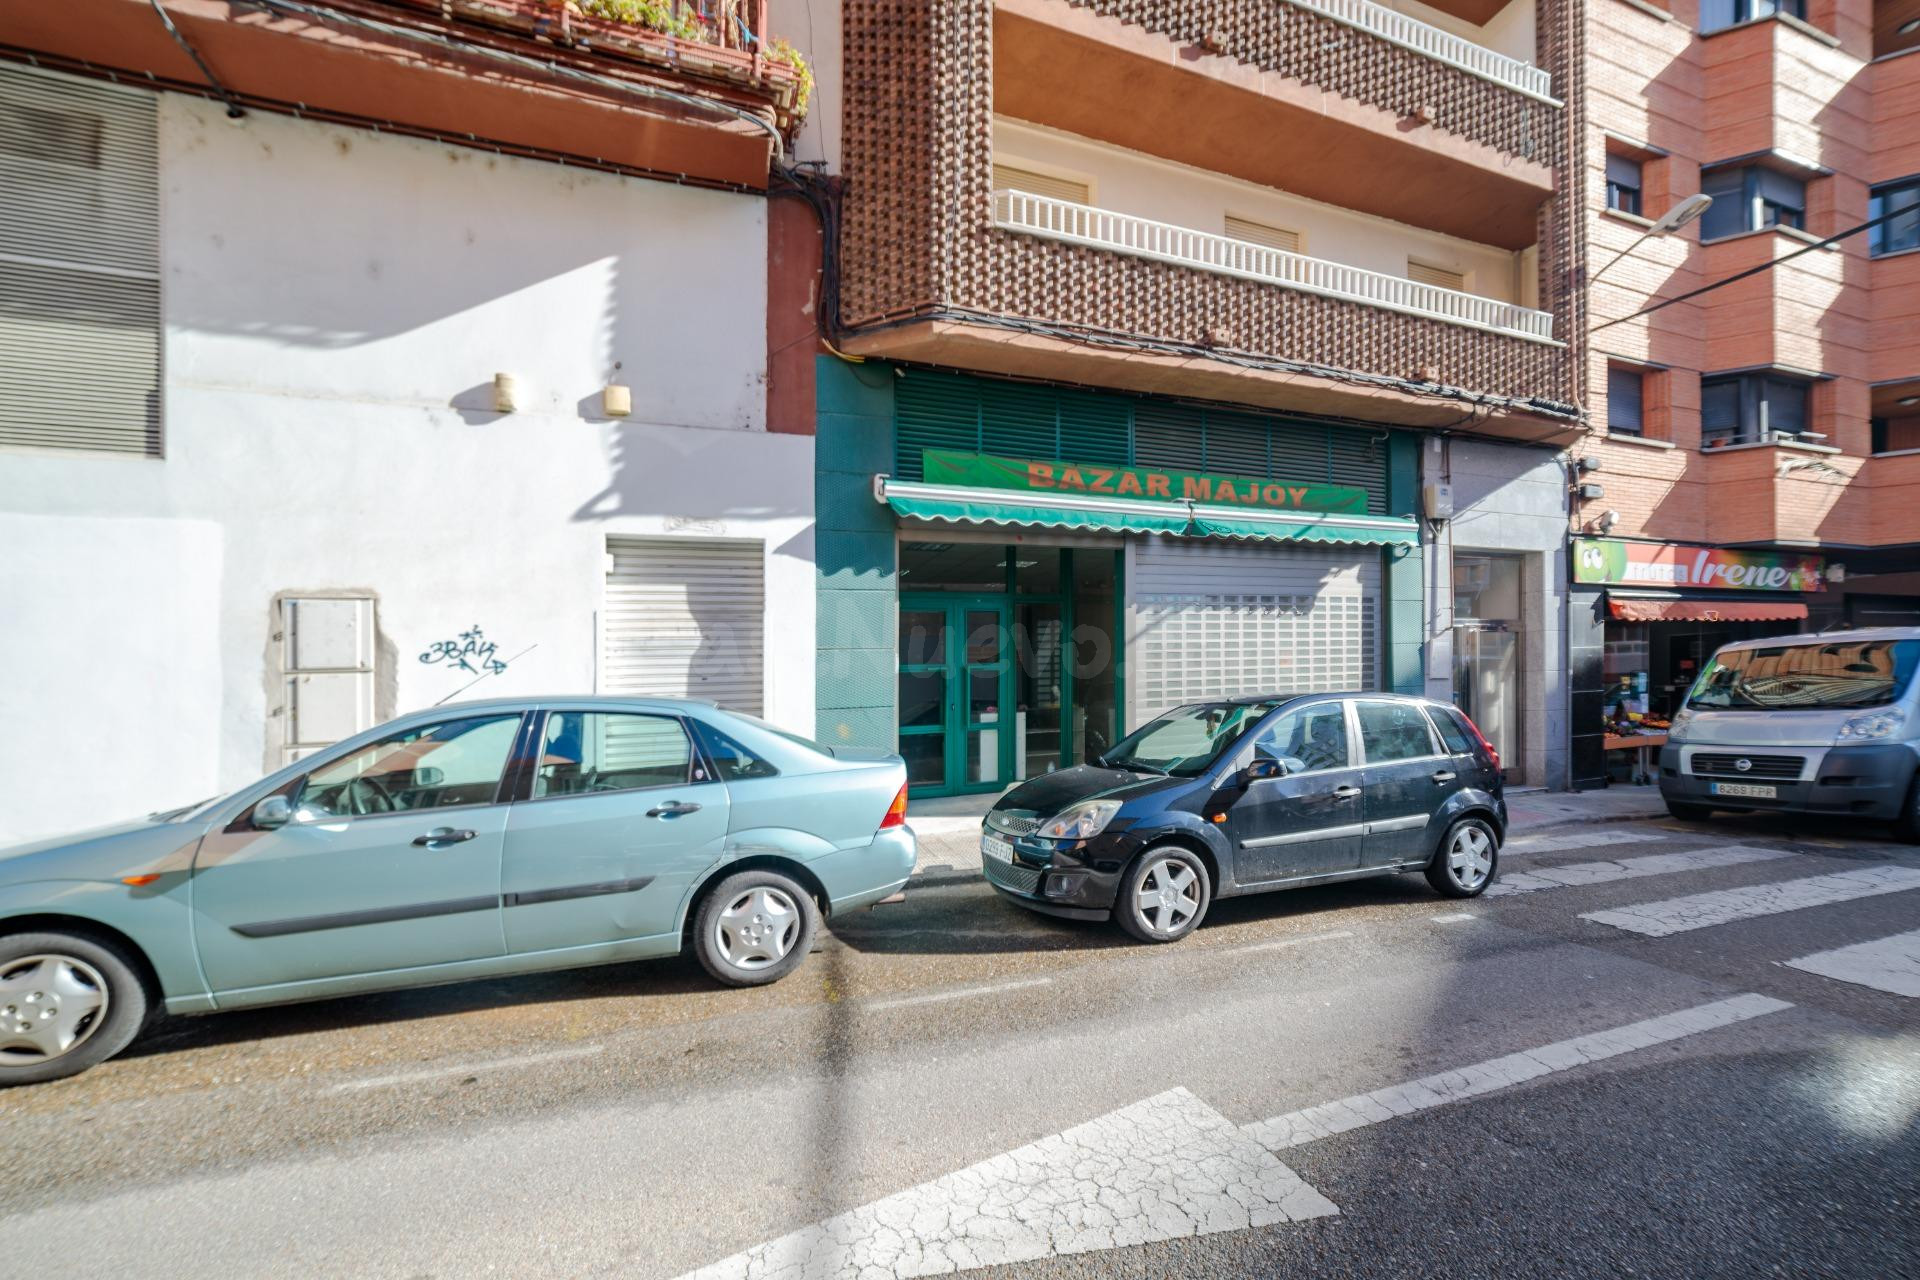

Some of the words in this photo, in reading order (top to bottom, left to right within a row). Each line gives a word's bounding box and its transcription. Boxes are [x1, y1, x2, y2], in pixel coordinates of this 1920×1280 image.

[1028, 463, 1171, 497] BAZAR
[1183, 476, 1308, 507] MAJOY
[1692, 550, 1792, 588] Irene
